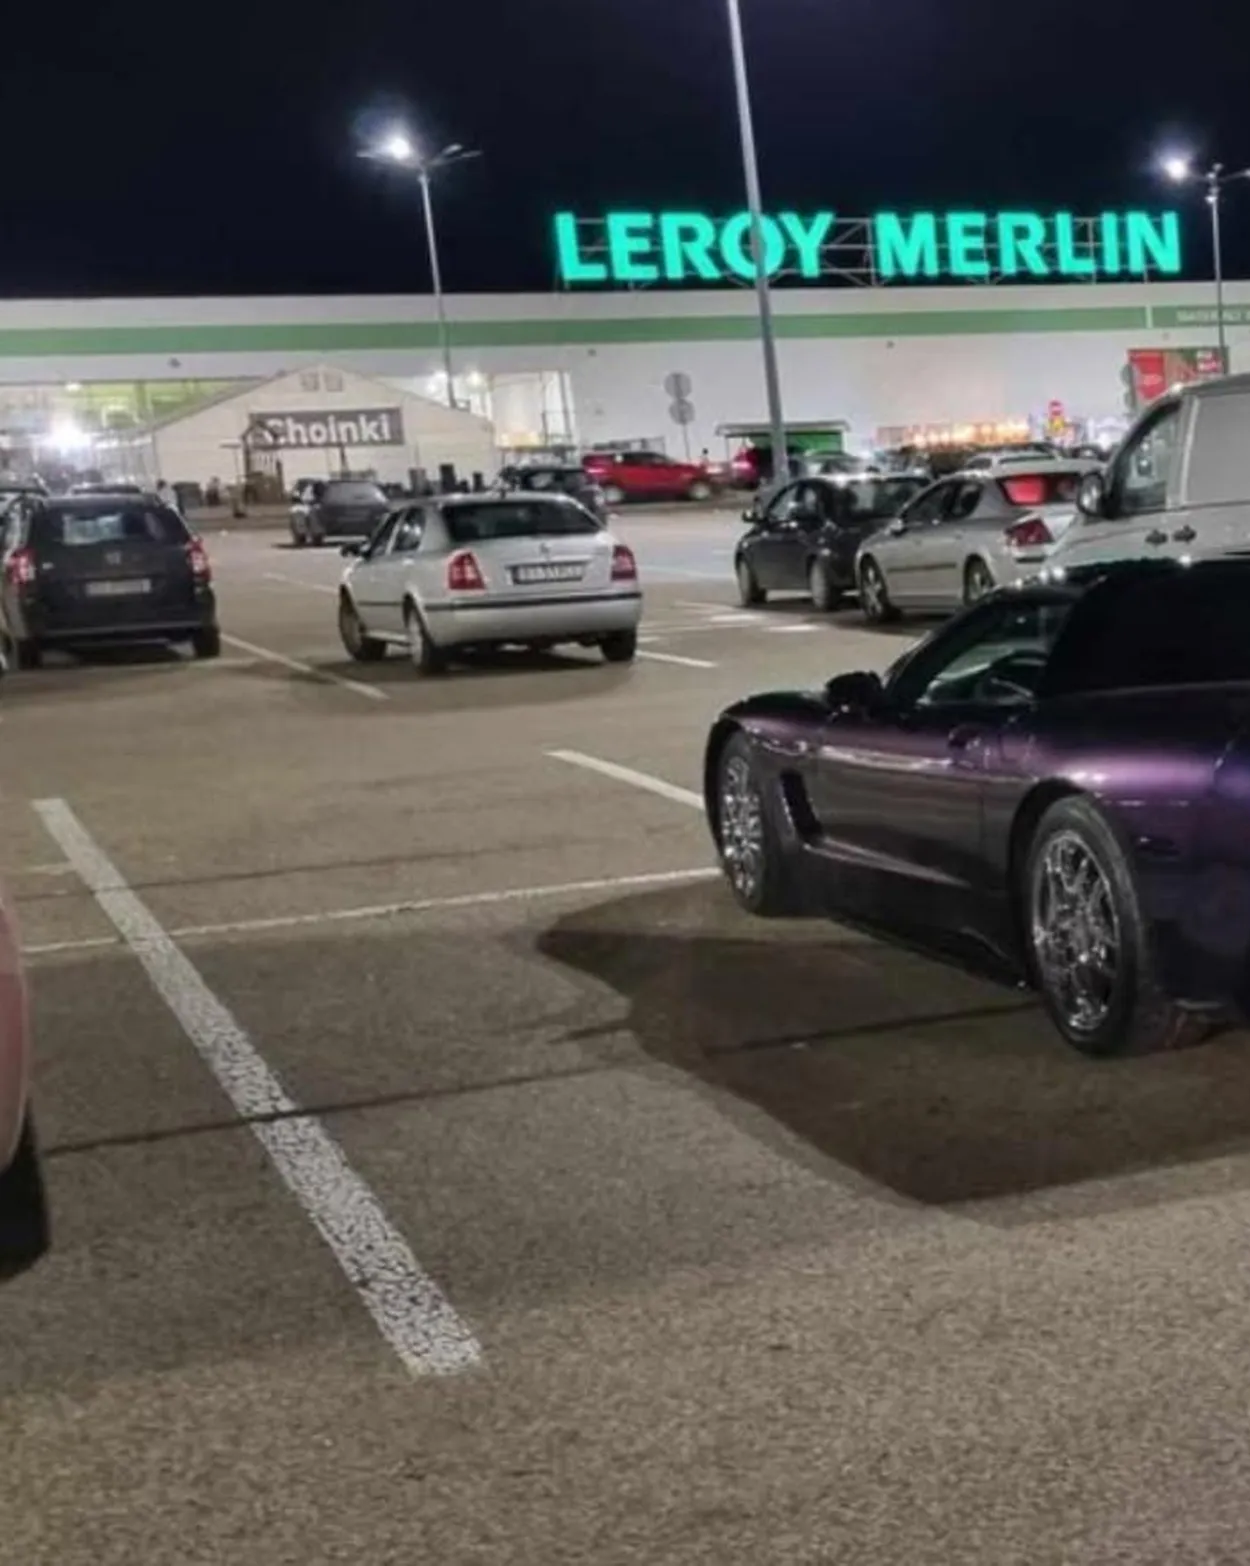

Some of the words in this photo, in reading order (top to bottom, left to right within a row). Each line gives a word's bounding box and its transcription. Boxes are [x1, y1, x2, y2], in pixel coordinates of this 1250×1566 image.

[554, 208, 834, 281] LEROY
[873, 210, 1182, 277] MERLIN
[261, 413, 391, 445] Choinki
